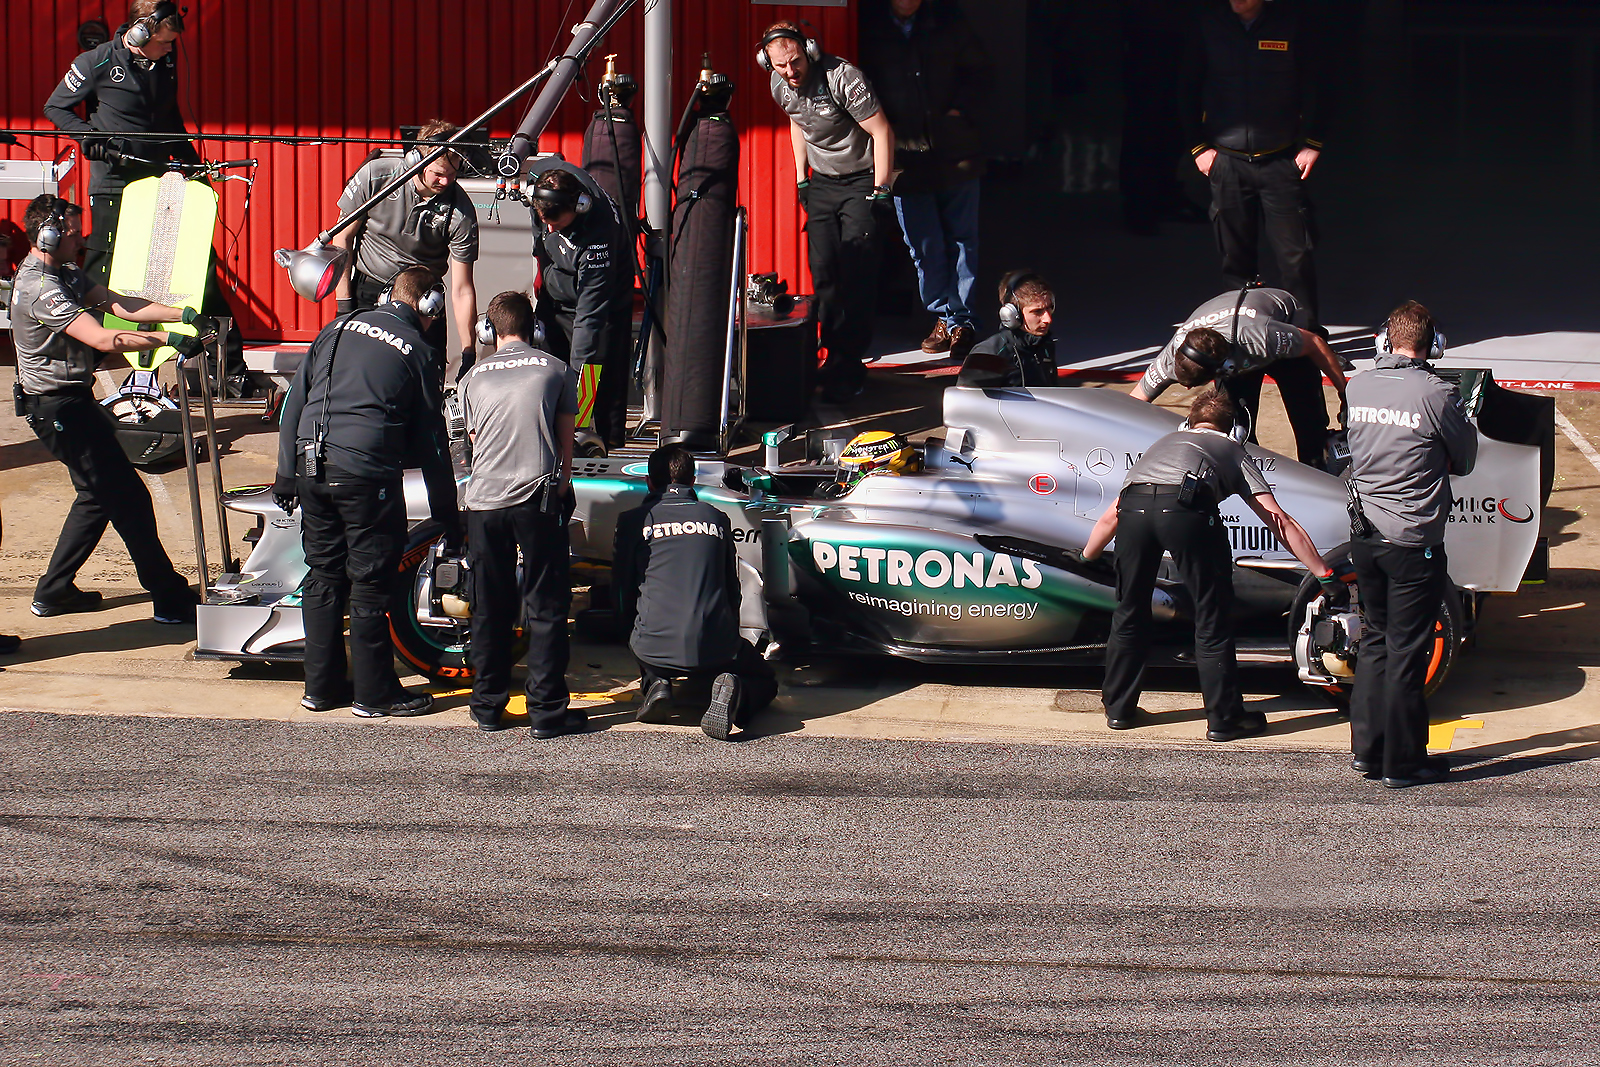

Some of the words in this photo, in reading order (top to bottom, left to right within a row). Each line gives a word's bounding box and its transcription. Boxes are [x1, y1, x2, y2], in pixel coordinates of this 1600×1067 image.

[471, 356, 548, 378] PETRONAS
[1494, 381, 1575, 390] IT-LANE
[1349, 406, 1422, 429] PETRONAS
[1036, 475, 1049, 492] E
[1448, 514, 1496, 524] BANK
[642, 520, 725, 541] PETRONAS
[812, 541, 1044, 590] PETRONAS
[848, 590, 962, 621] reimagining
[967, 602, 1039, 621] energy
